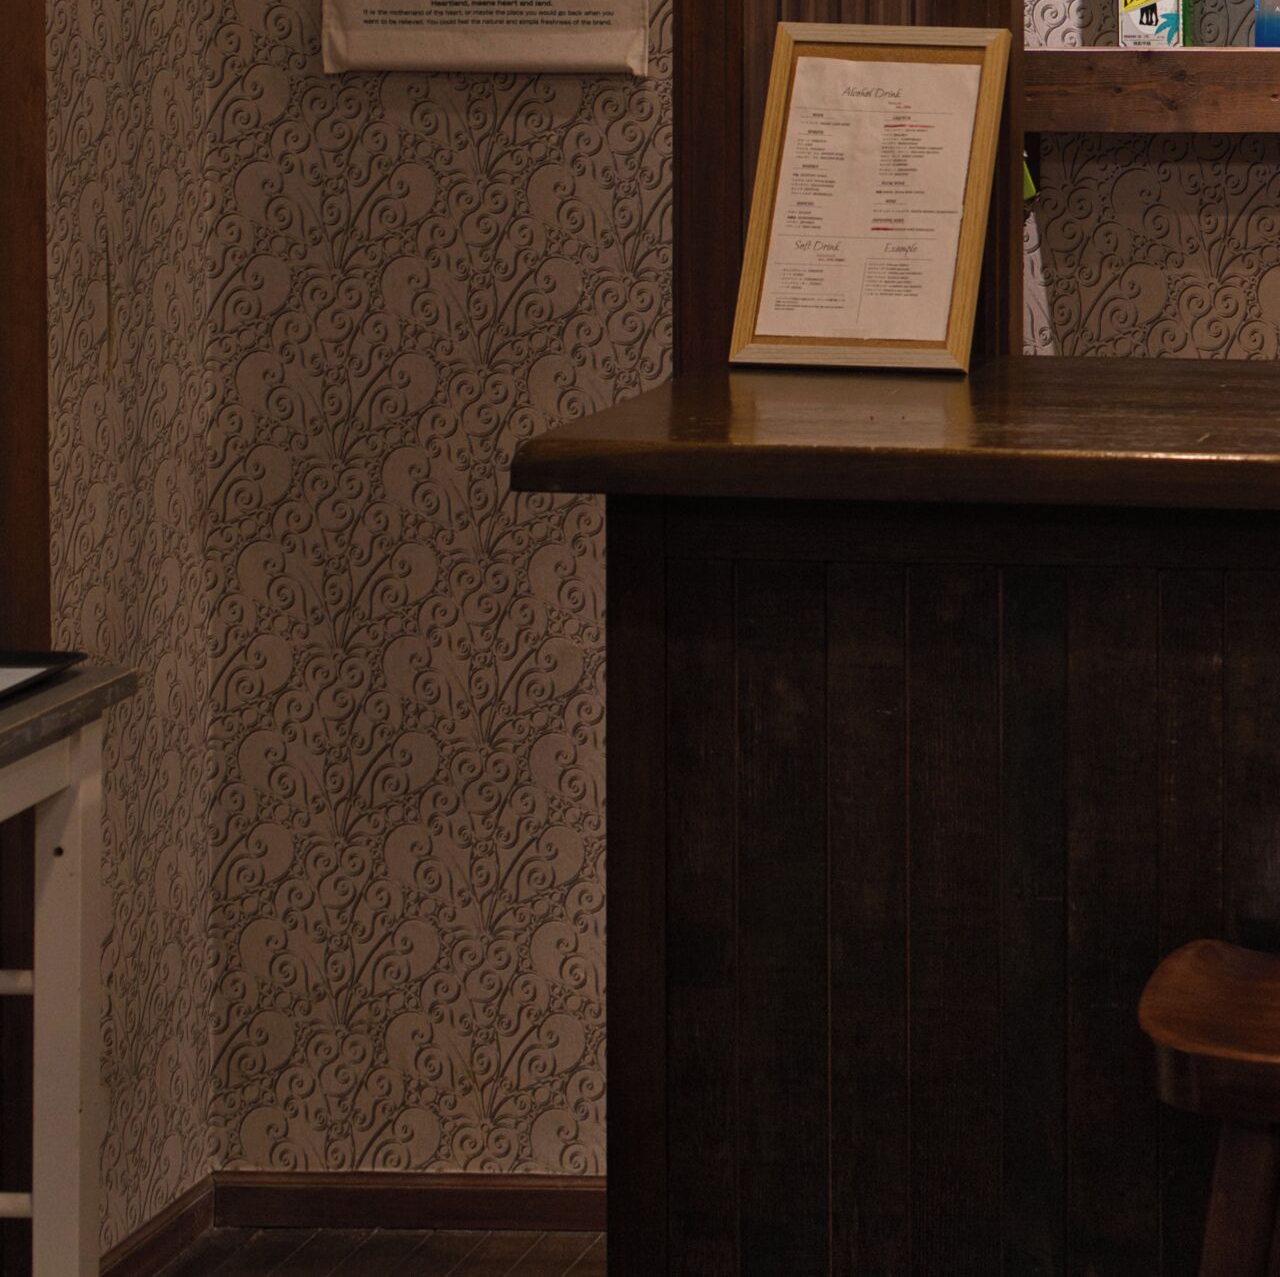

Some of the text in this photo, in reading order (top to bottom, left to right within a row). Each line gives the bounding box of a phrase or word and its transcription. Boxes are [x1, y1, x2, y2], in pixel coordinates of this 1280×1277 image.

[841, 86, 904, 99] Alcohol Drink
[794, 240, 841, 252] Soft Drink
[884, 242, 919, 257] Example
